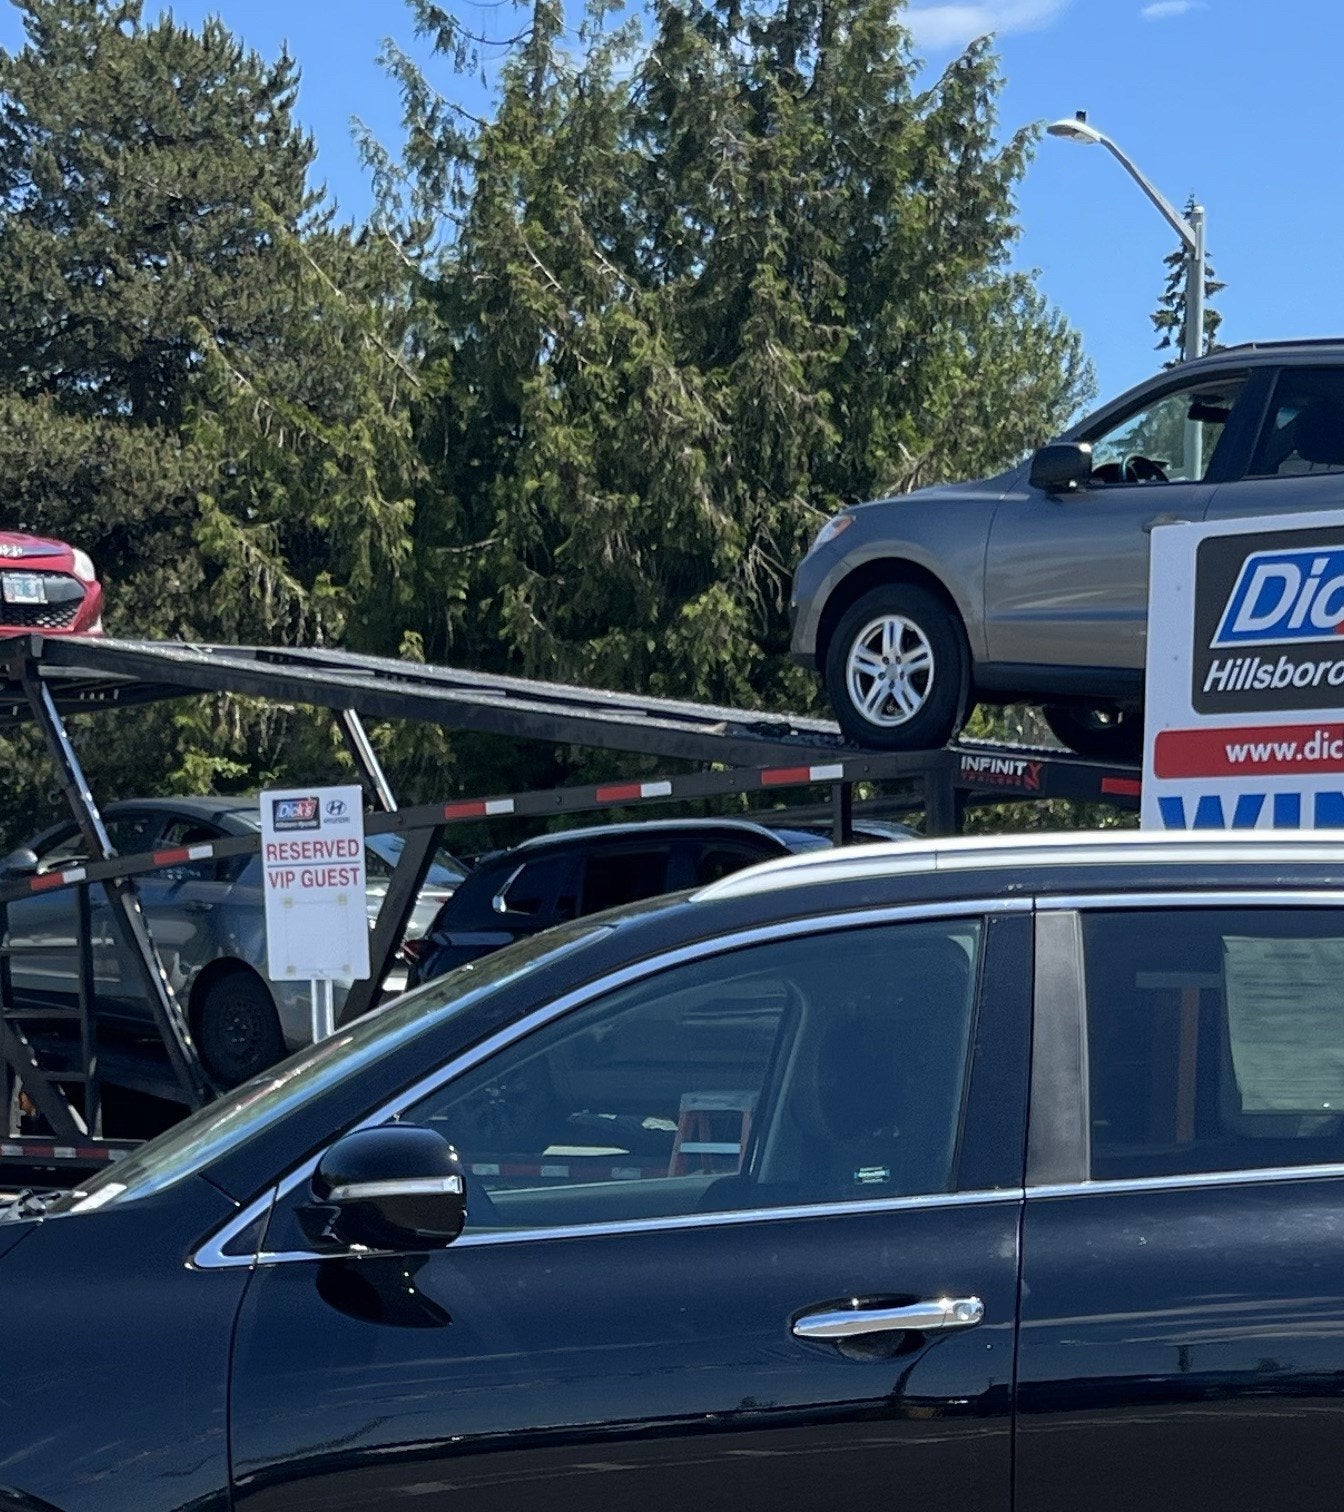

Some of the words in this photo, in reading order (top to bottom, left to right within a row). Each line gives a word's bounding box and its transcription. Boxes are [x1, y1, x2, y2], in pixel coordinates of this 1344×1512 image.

[266, 839, 360, 861] RESERVED
[268, 870, 296, 889] VIP
[301, 867, 360, 888] GUEST
